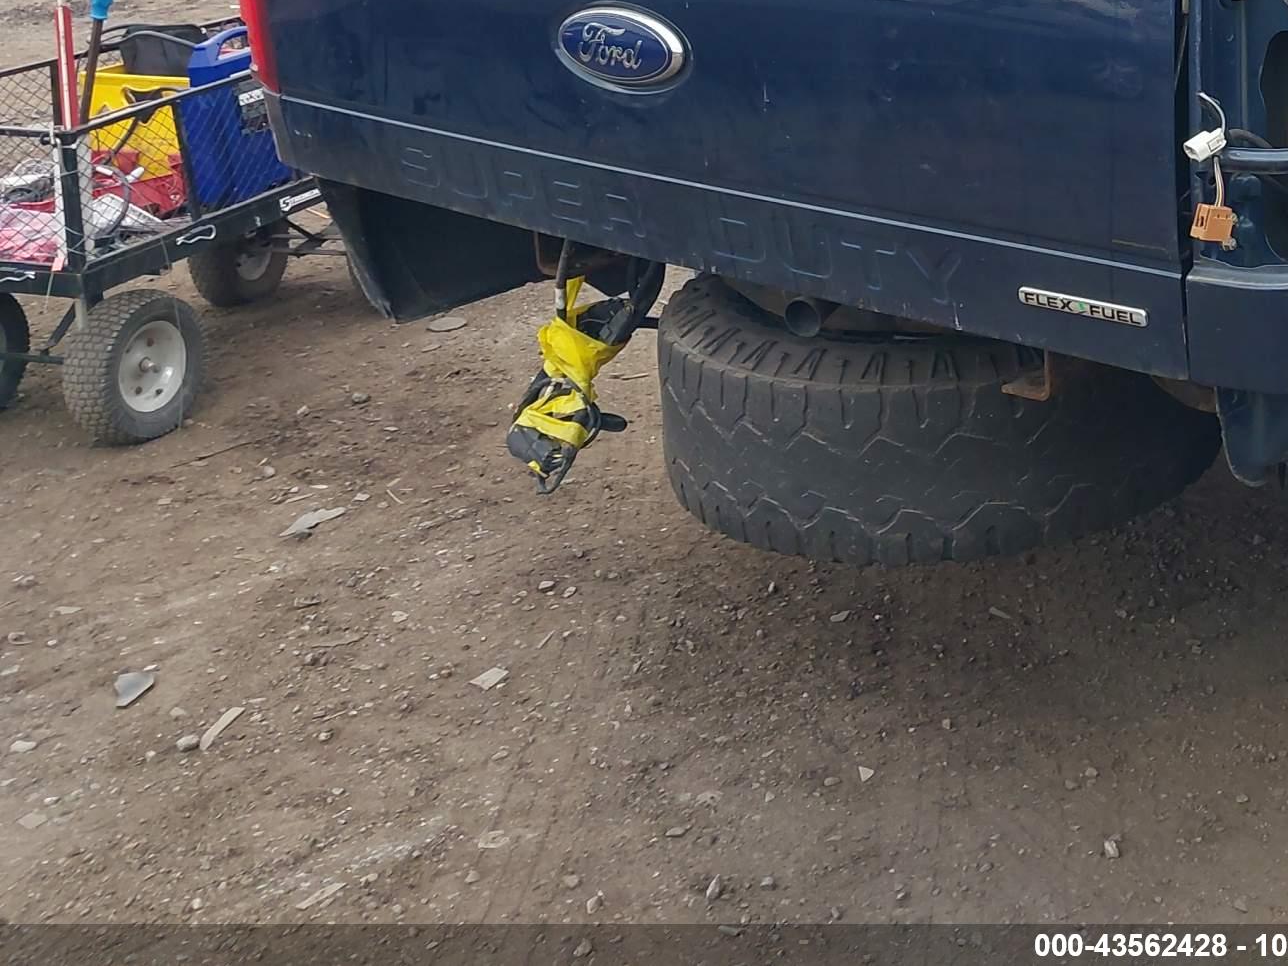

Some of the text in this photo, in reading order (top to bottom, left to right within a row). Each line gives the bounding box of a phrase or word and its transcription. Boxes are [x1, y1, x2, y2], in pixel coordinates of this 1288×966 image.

[579, 22, 643, 70] Ford
[401, 145, 964, 308] SUPER DUTY
[1023, 290, 1141, 326] FLEX FUEL
